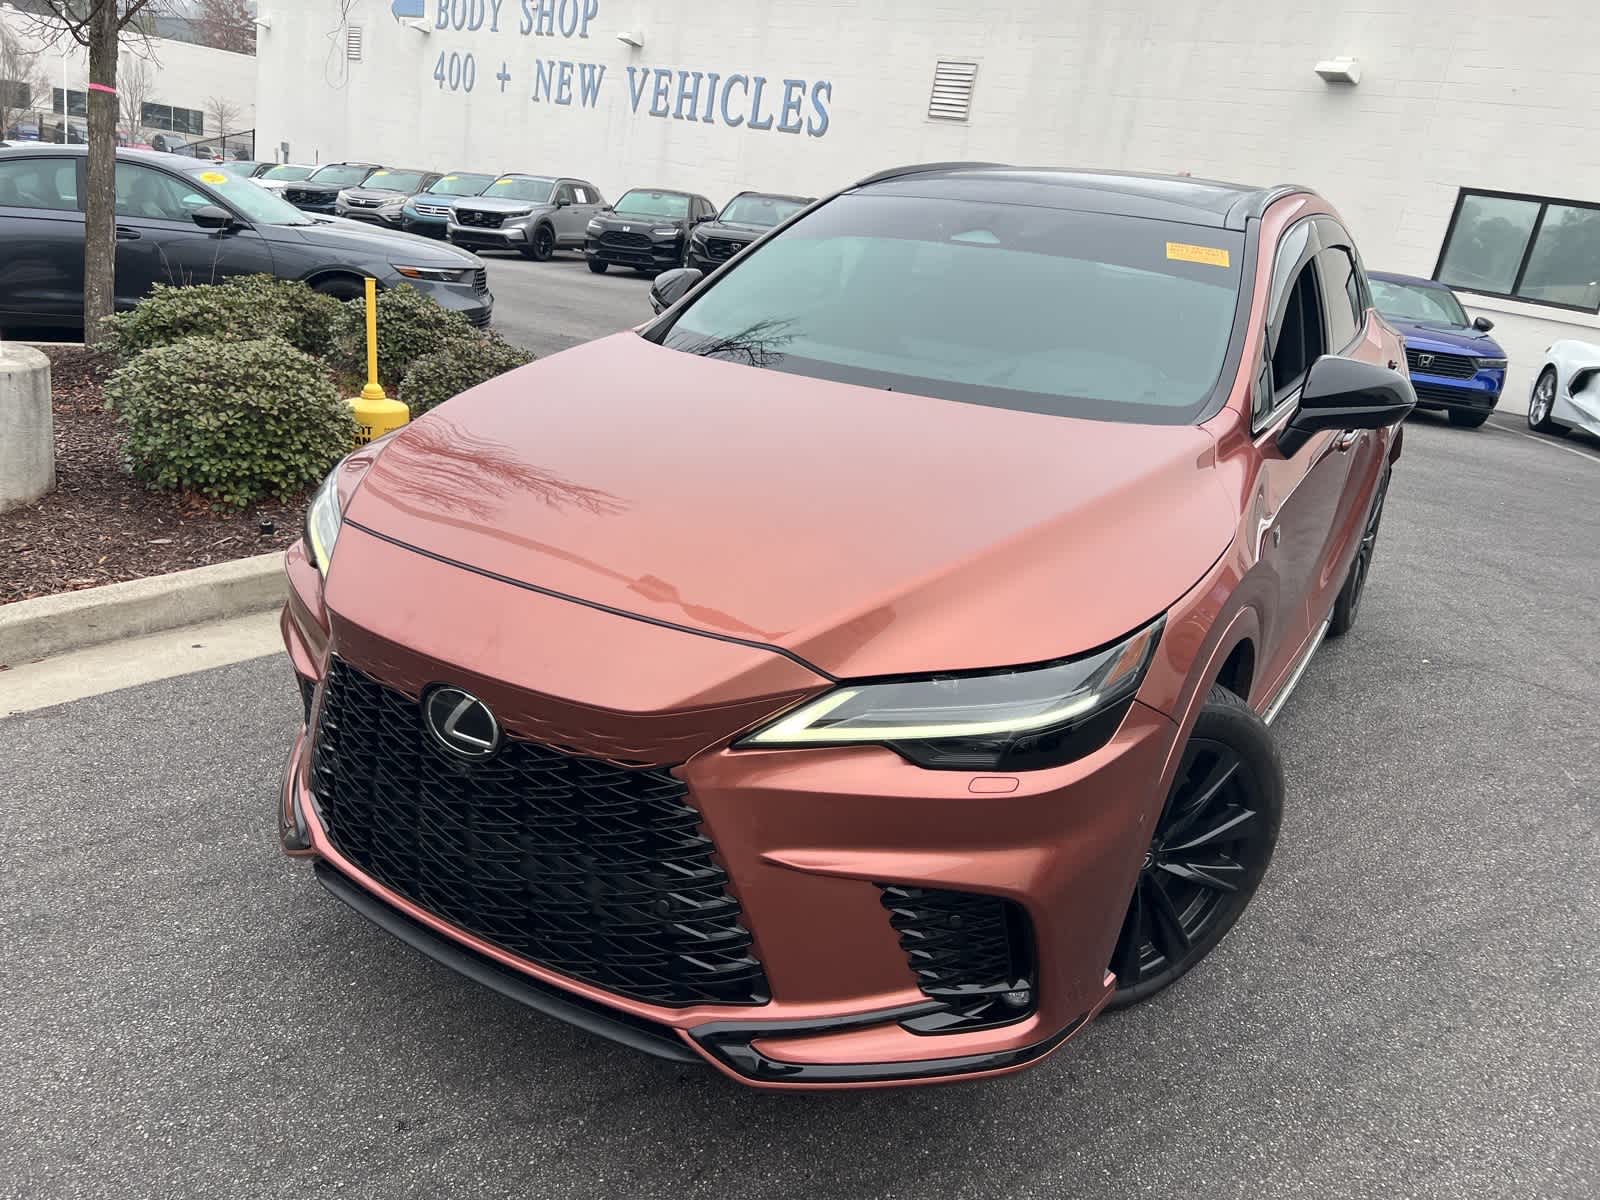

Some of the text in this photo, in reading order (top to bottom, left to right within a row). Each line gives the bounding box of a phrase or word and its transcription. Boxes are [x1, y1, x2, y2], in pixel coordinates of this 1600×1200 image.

[435, 0, 599, 39] BODY SHOP
[434, 50, 832, 137] 400 + NEW VEHICLES
